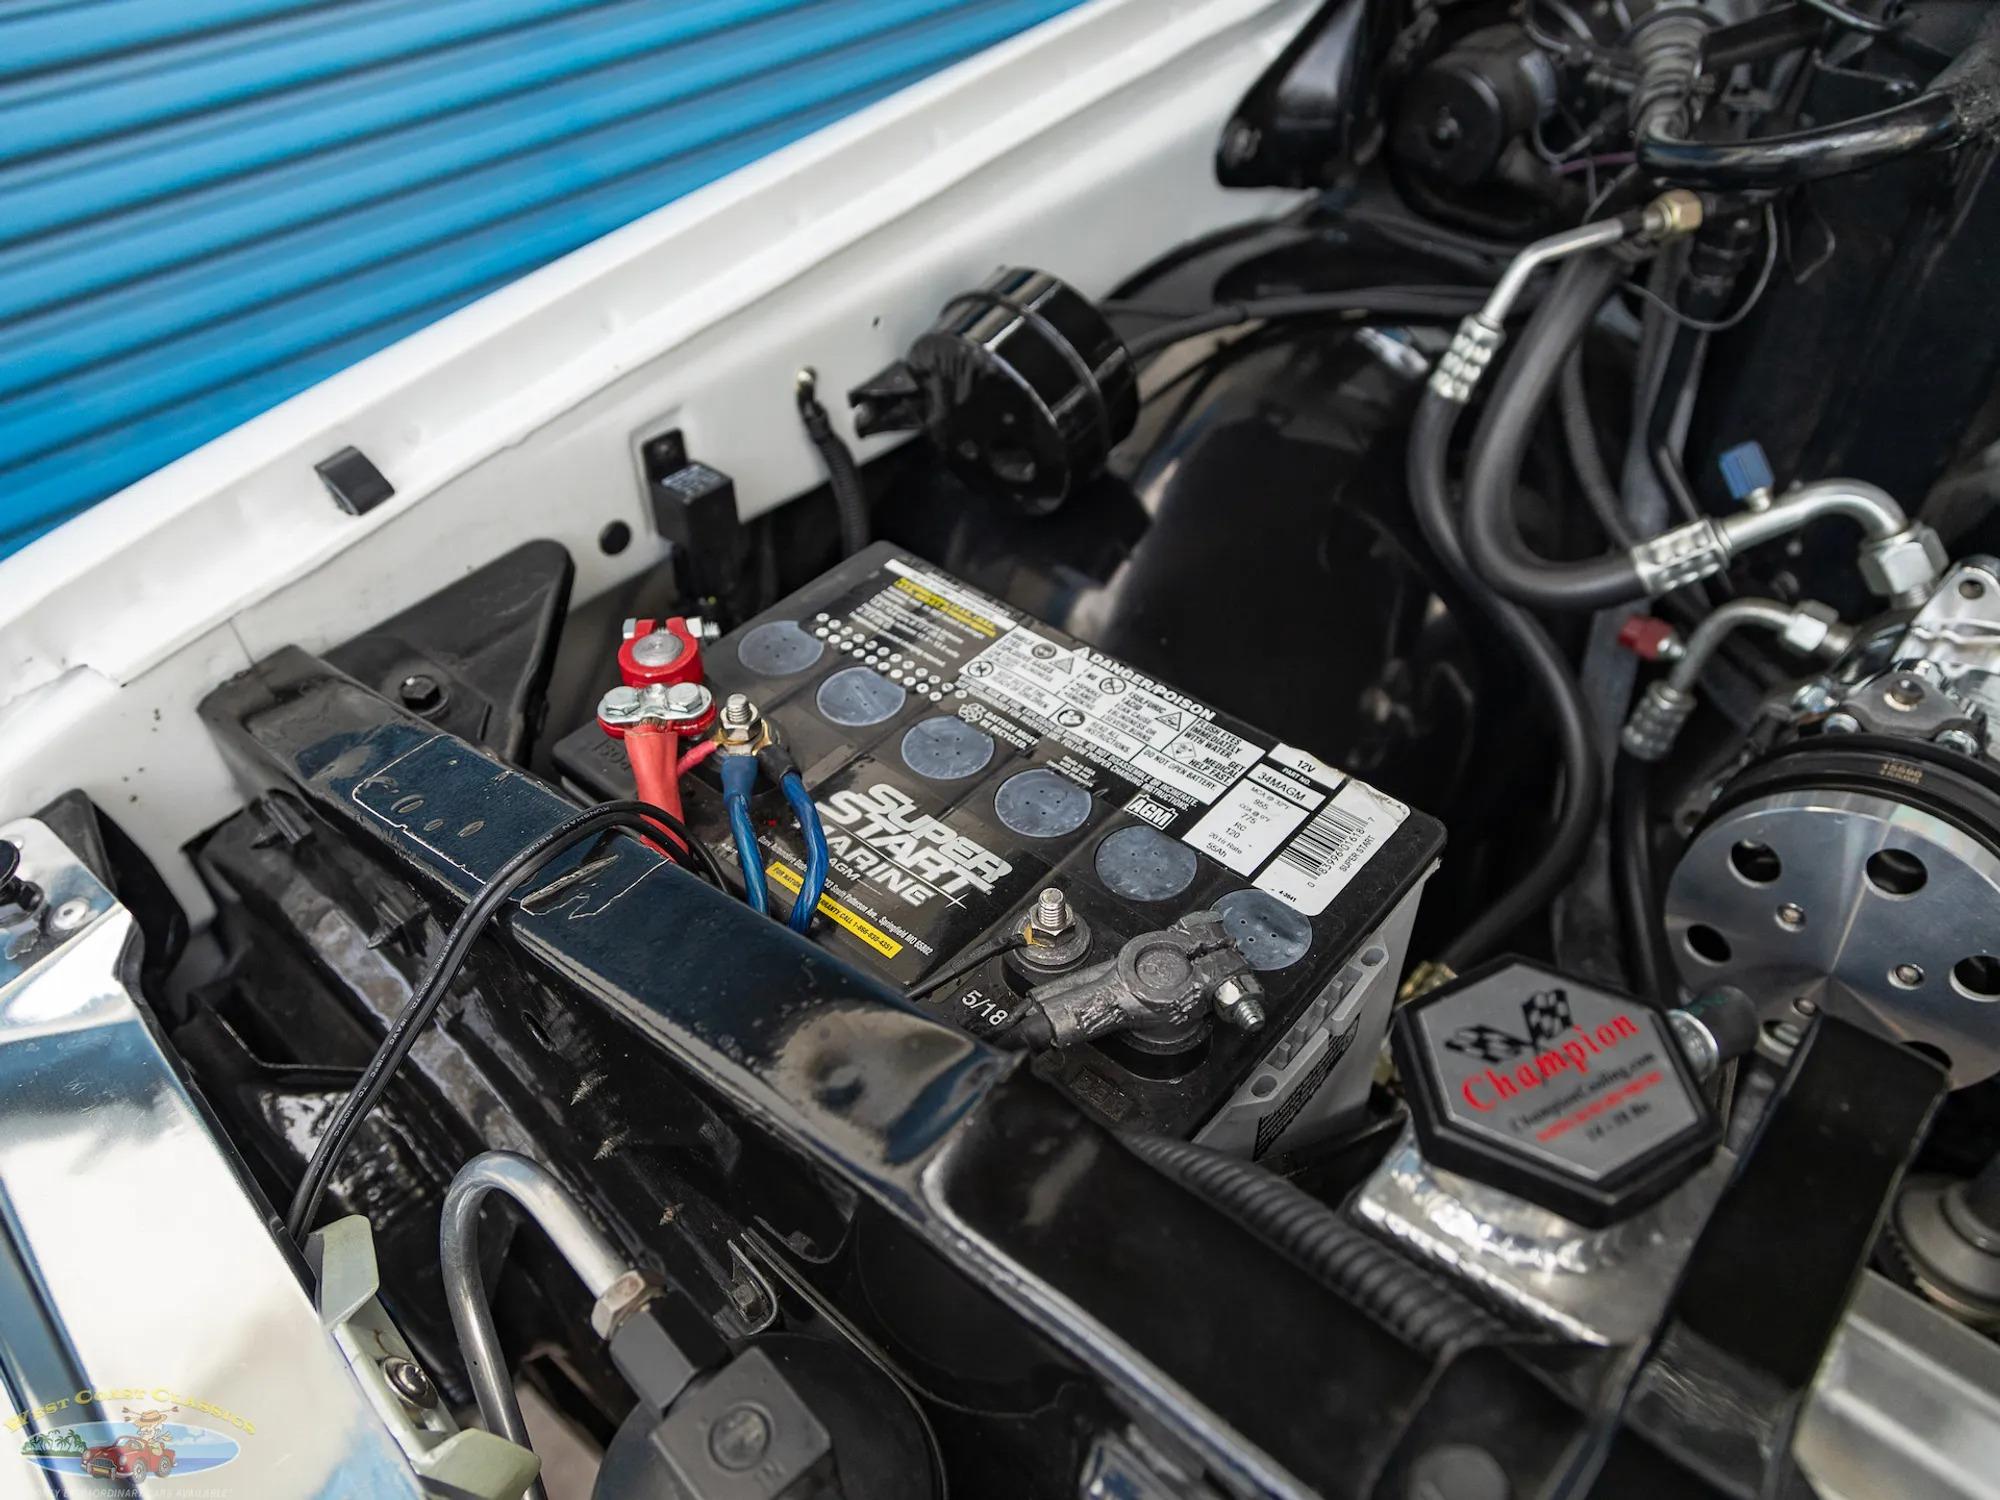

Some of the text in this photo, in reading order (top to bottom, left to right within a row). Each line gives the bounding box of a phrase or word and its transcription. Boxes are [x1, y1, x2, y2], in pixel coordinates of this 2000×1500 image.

[1089, 653, 1217, 721] DANGER/POISON
[1183, 730, 1206, 745] WITH
[1189, 724, 1242, 754] IMMEDIATELY
[1195, 719, 1242, 745] FLUSH EYES
[1152, 754, 1170, 766] NOT
[1187, 758, 1234, 785] HELP FAST.
[1202, 756, 1240, 778] MEDICAL
[1227, 760, 1245, 772] GET
[1280, 766, 1300, 779] PART
[1295, 759, 1316, 773] 12V
[1256, 771, 1306, 802] 34MAGM
[1128, 798, 1173, 826] AGM
[1252, 798, 1270, 810] 955
[1232, 821, 1247, 831] RC
[1239, 812, 1258, 824] 775
[814, 790, 996, 895] START
[867, 783, 1013, 884] SUPER
[1224, 827, 1241, 838] 120
[1204, 841, 1229, 857] 55Ah
[1317, 848, 1344, 875] 83996
[1339, 825, 1365, 852] 01618
[1338, 833, 1375, 873] SUPER START
[828, 857, 861, 881] AGM
[876, 914, 909, 940] Springfield
[961, 989, 1009, 1027] 5/18
[1461, 1014, 1641, 1113] Champion
